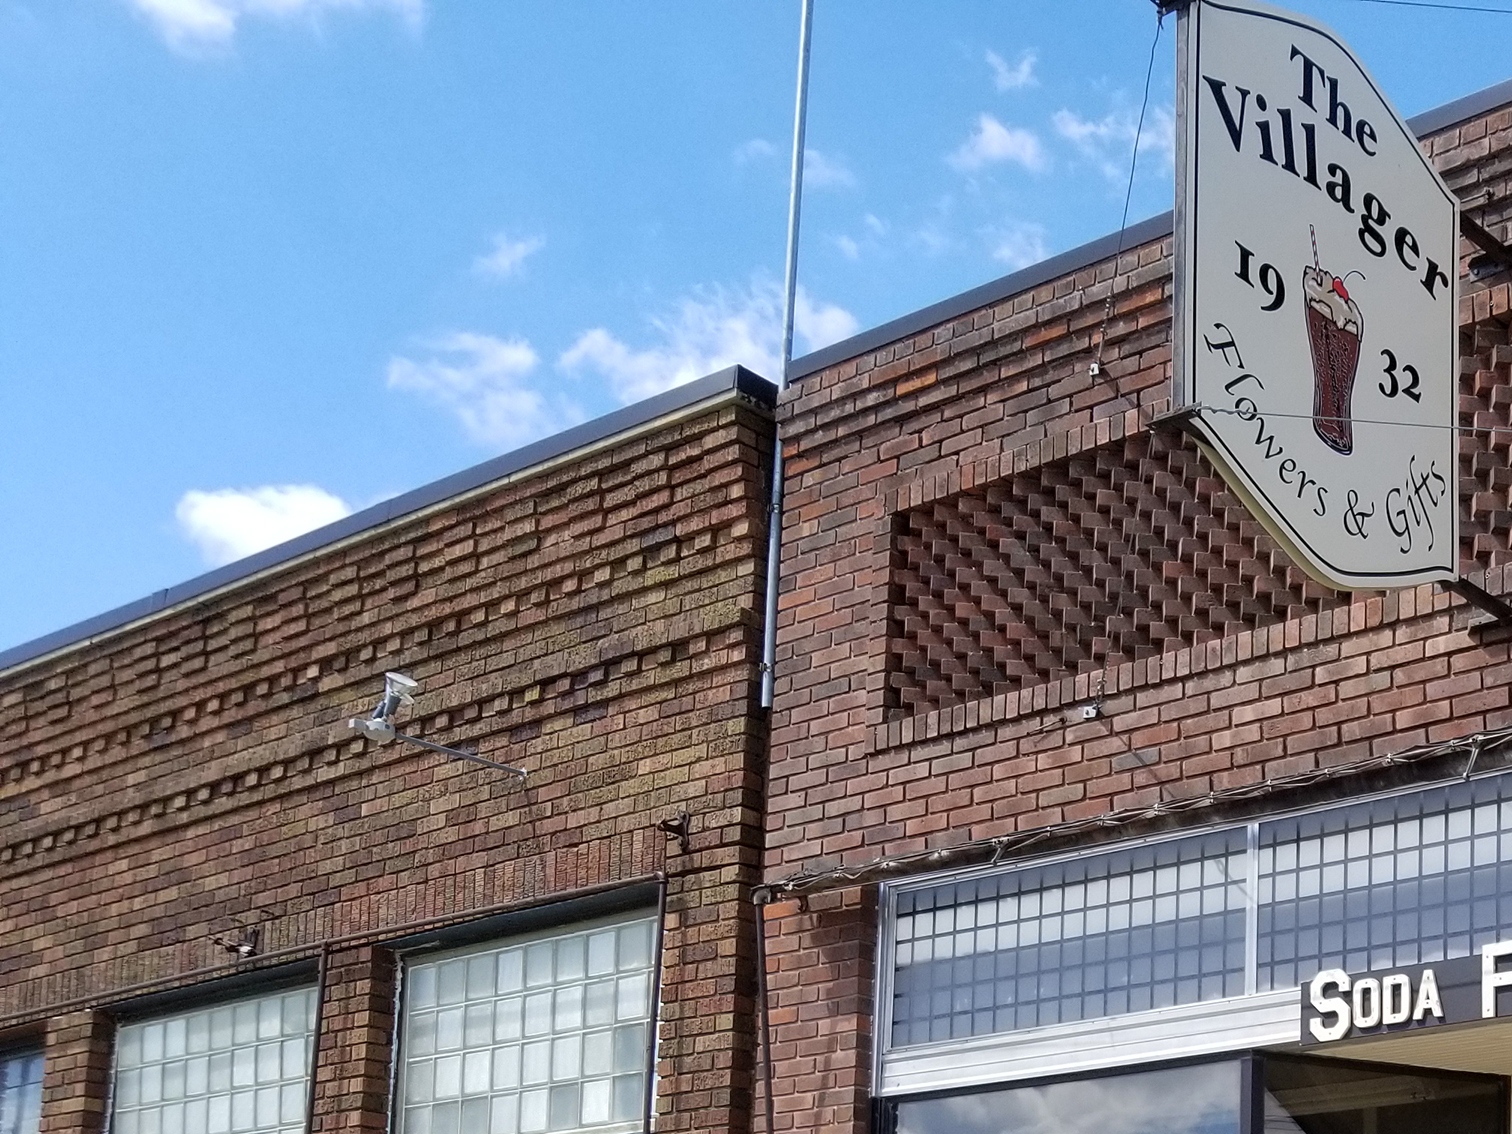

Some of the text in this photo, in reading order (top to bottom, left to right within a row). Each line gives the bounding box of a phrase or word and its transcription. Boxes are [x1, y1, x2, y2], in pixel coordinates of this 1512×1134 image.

[1289, 43, 1378, 157] The
[1201, 74, 1452, 302] Villager
[1234, 239, 1286, 312] 19
[1378, 347, 1422, 404] 32
[1203, 321, 1447, 555] Flowers & Gifts
[1309, 967, 1444, 1043] SODA
